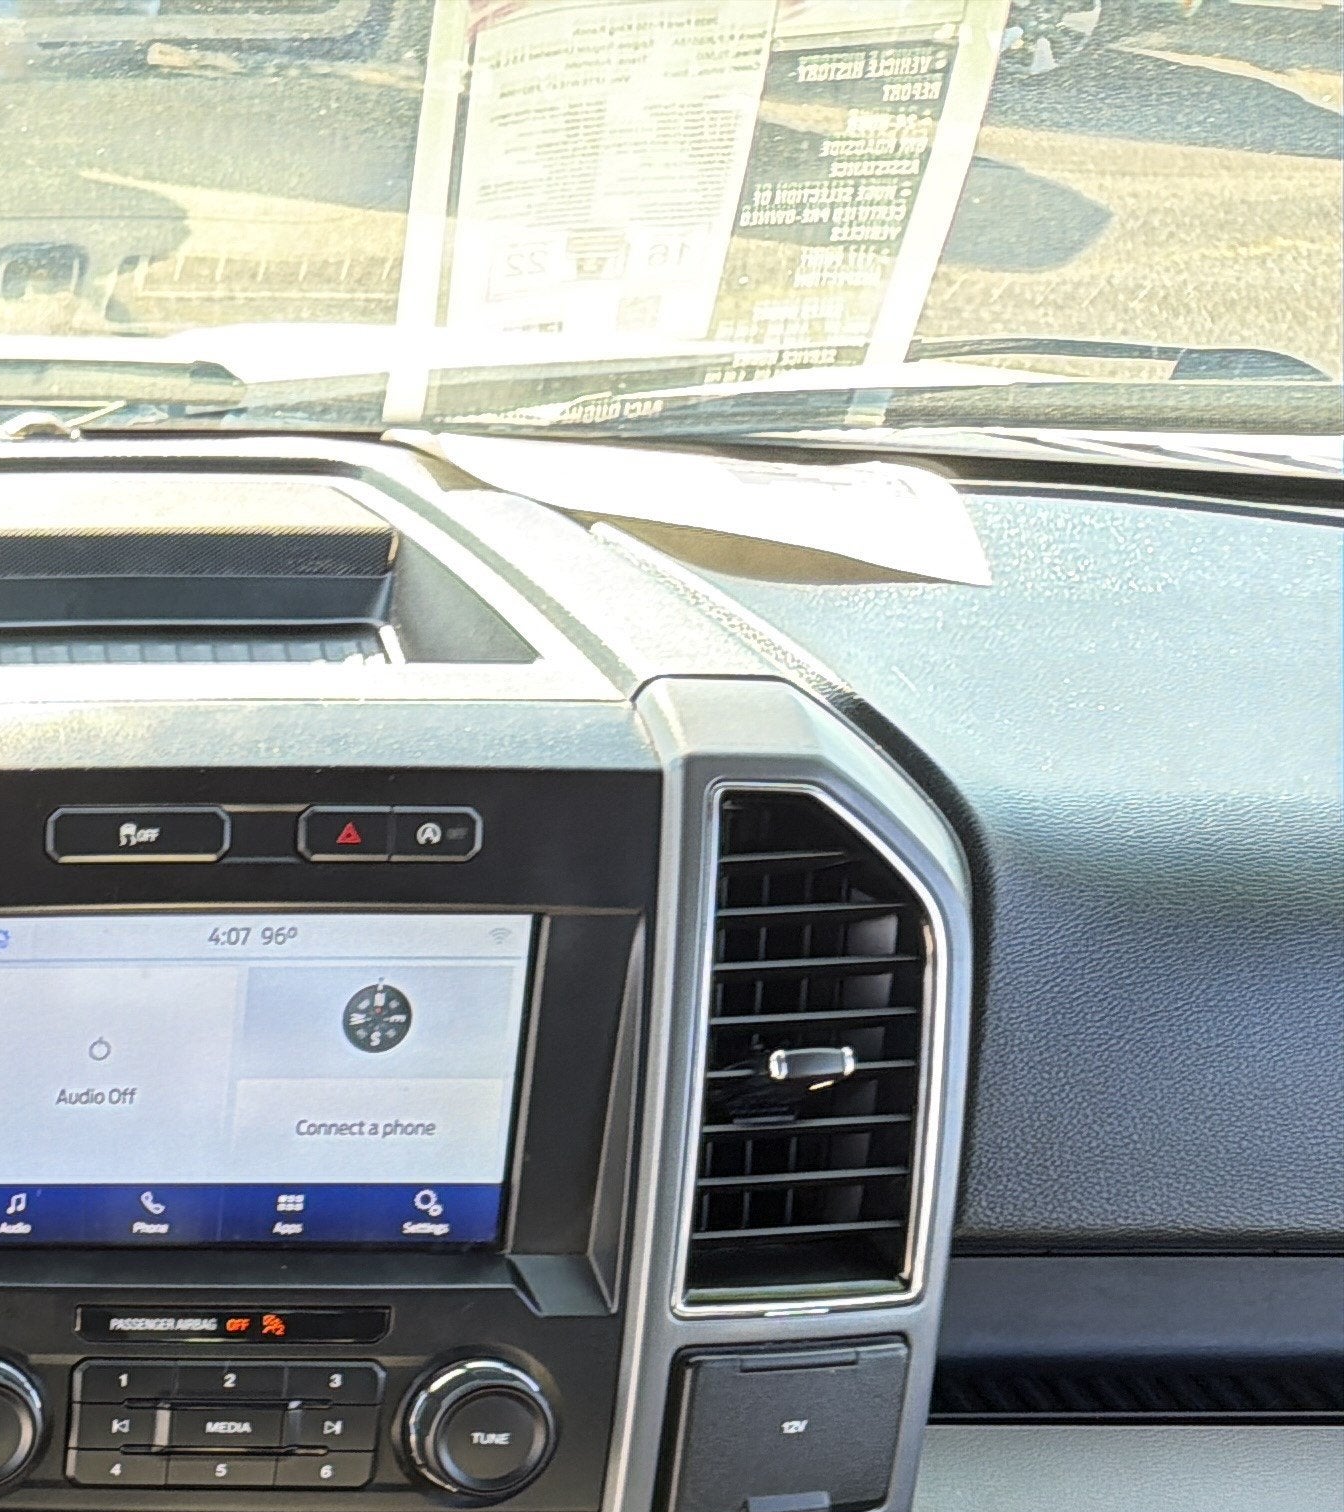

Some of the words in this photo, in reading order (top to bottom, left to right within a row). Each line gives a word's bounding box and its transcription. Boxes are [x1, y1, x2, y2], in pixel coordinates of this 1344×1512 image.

[207, 926, 252, 946] 4:07
[55, 1087, 105, 1106] Audio
[107, 1086, 138, 1106] Off
[295, 1118, 366, 1138] Connect
[367, 1122, 380, 1138] a
[382, 1118, 437, 1140] phone
[132, 1220, 170, 1235] Phone
[272, 1221, 305, 1236] Apps
[401, 1220, 451, 1237] Settings
[109, 1317, 176, 1331] PASSENGER
[175, 1317, 218, 1331] AIRBAG
[225, 1318, 252, 1332] OFF
[118, 1373, 129, 1388] 1
[222, 1372, 237, 1388] 2
[328, 1373, 343, 1389] 3
[205, 1421, 252, 1434] MEDIA
[780, 1419, 809, 1434] 12V
[470, 1431, 512, 1445] TUNE
[109, 1462, 122, 1477] 4
[214, 1463, 228, 1478] 5
[319, 1464, 333, 1479] 6
